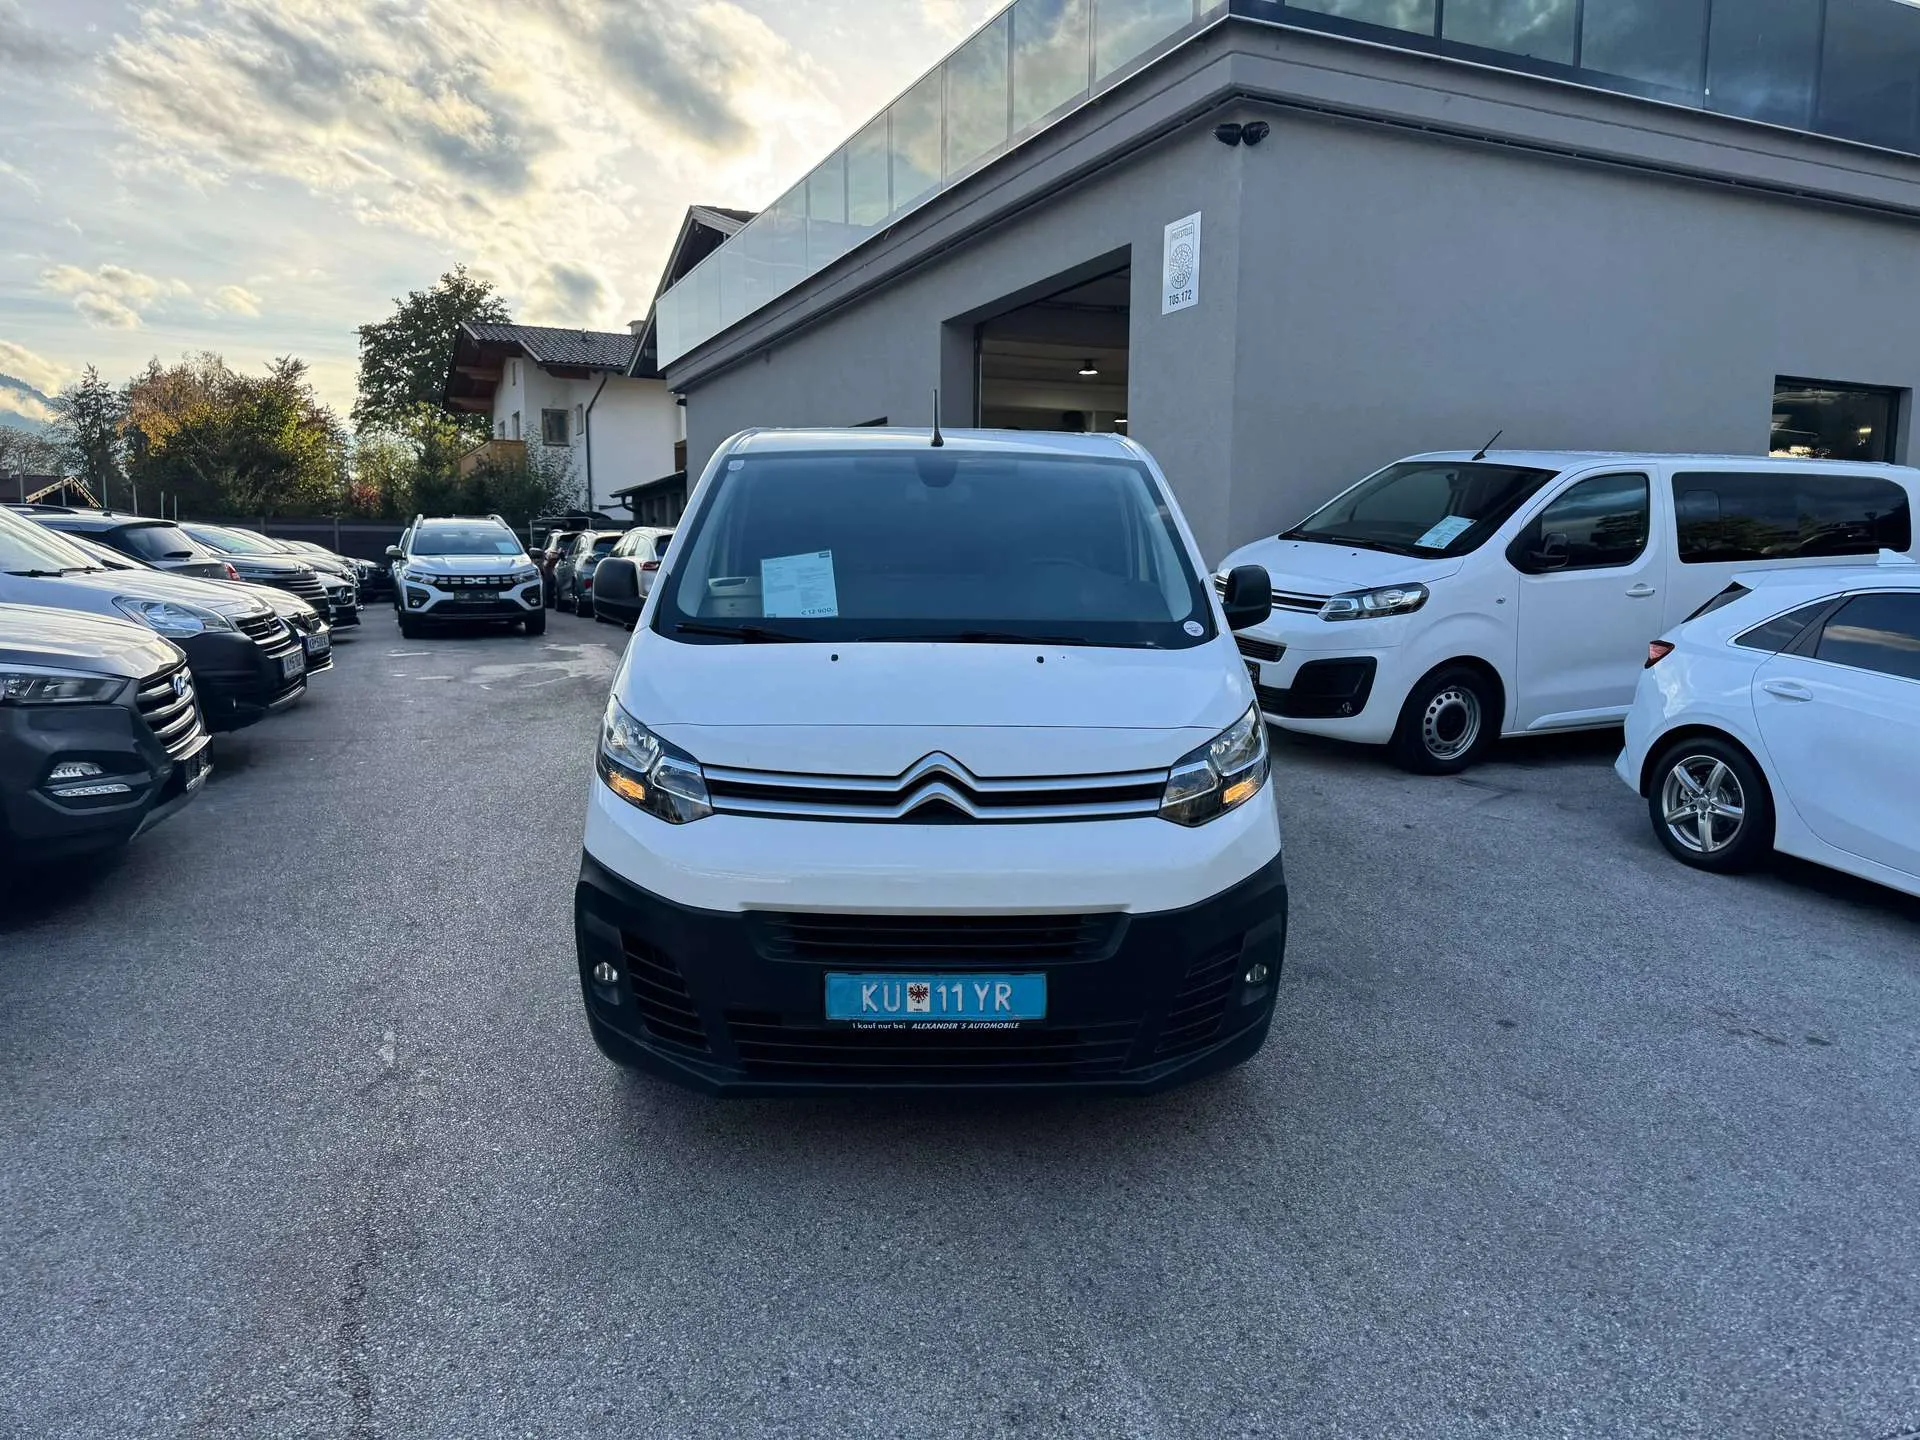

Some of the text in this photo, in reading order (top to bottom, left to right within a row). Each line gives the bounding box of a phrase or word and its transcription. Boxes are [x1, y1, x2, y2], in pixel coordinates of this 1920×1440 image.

[862, 982, 1013, 1012] KU 11 YR
[911, 1022, 958, 1030] ALEXANDER
